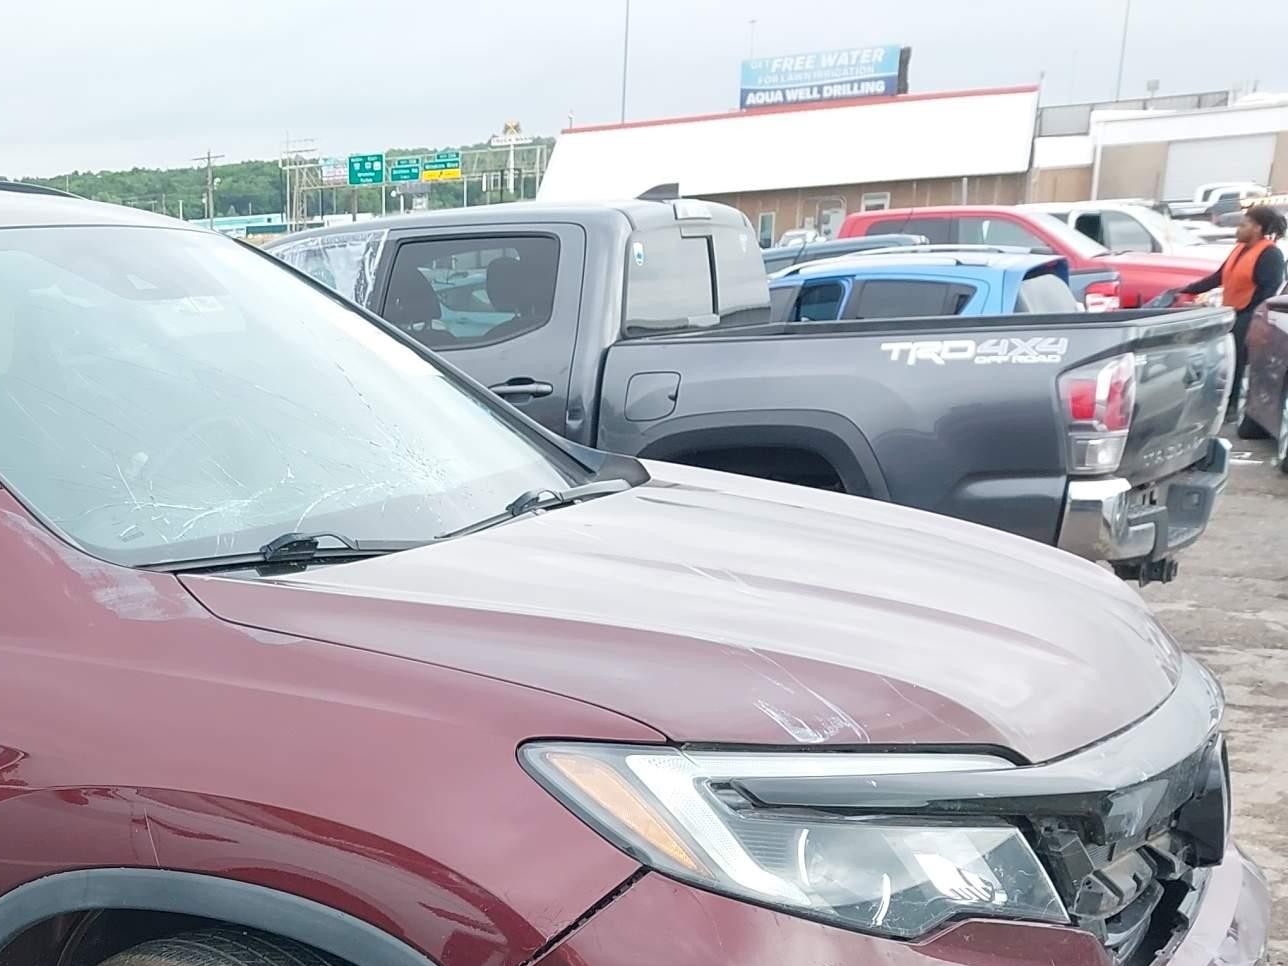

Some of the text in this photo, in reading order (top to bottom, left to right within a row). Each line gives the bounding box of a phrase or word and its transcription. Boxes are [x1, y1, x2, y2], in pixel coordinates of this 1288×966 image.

[771, 56, 816, 72] FREE
[821, 48, 885, 68] WATER
[746, 80, 886, 105] AQUA WELL DRILLING
[880, 340, 975, 365] TRD
[974, 354, 1062, 365] OFF ROAD
